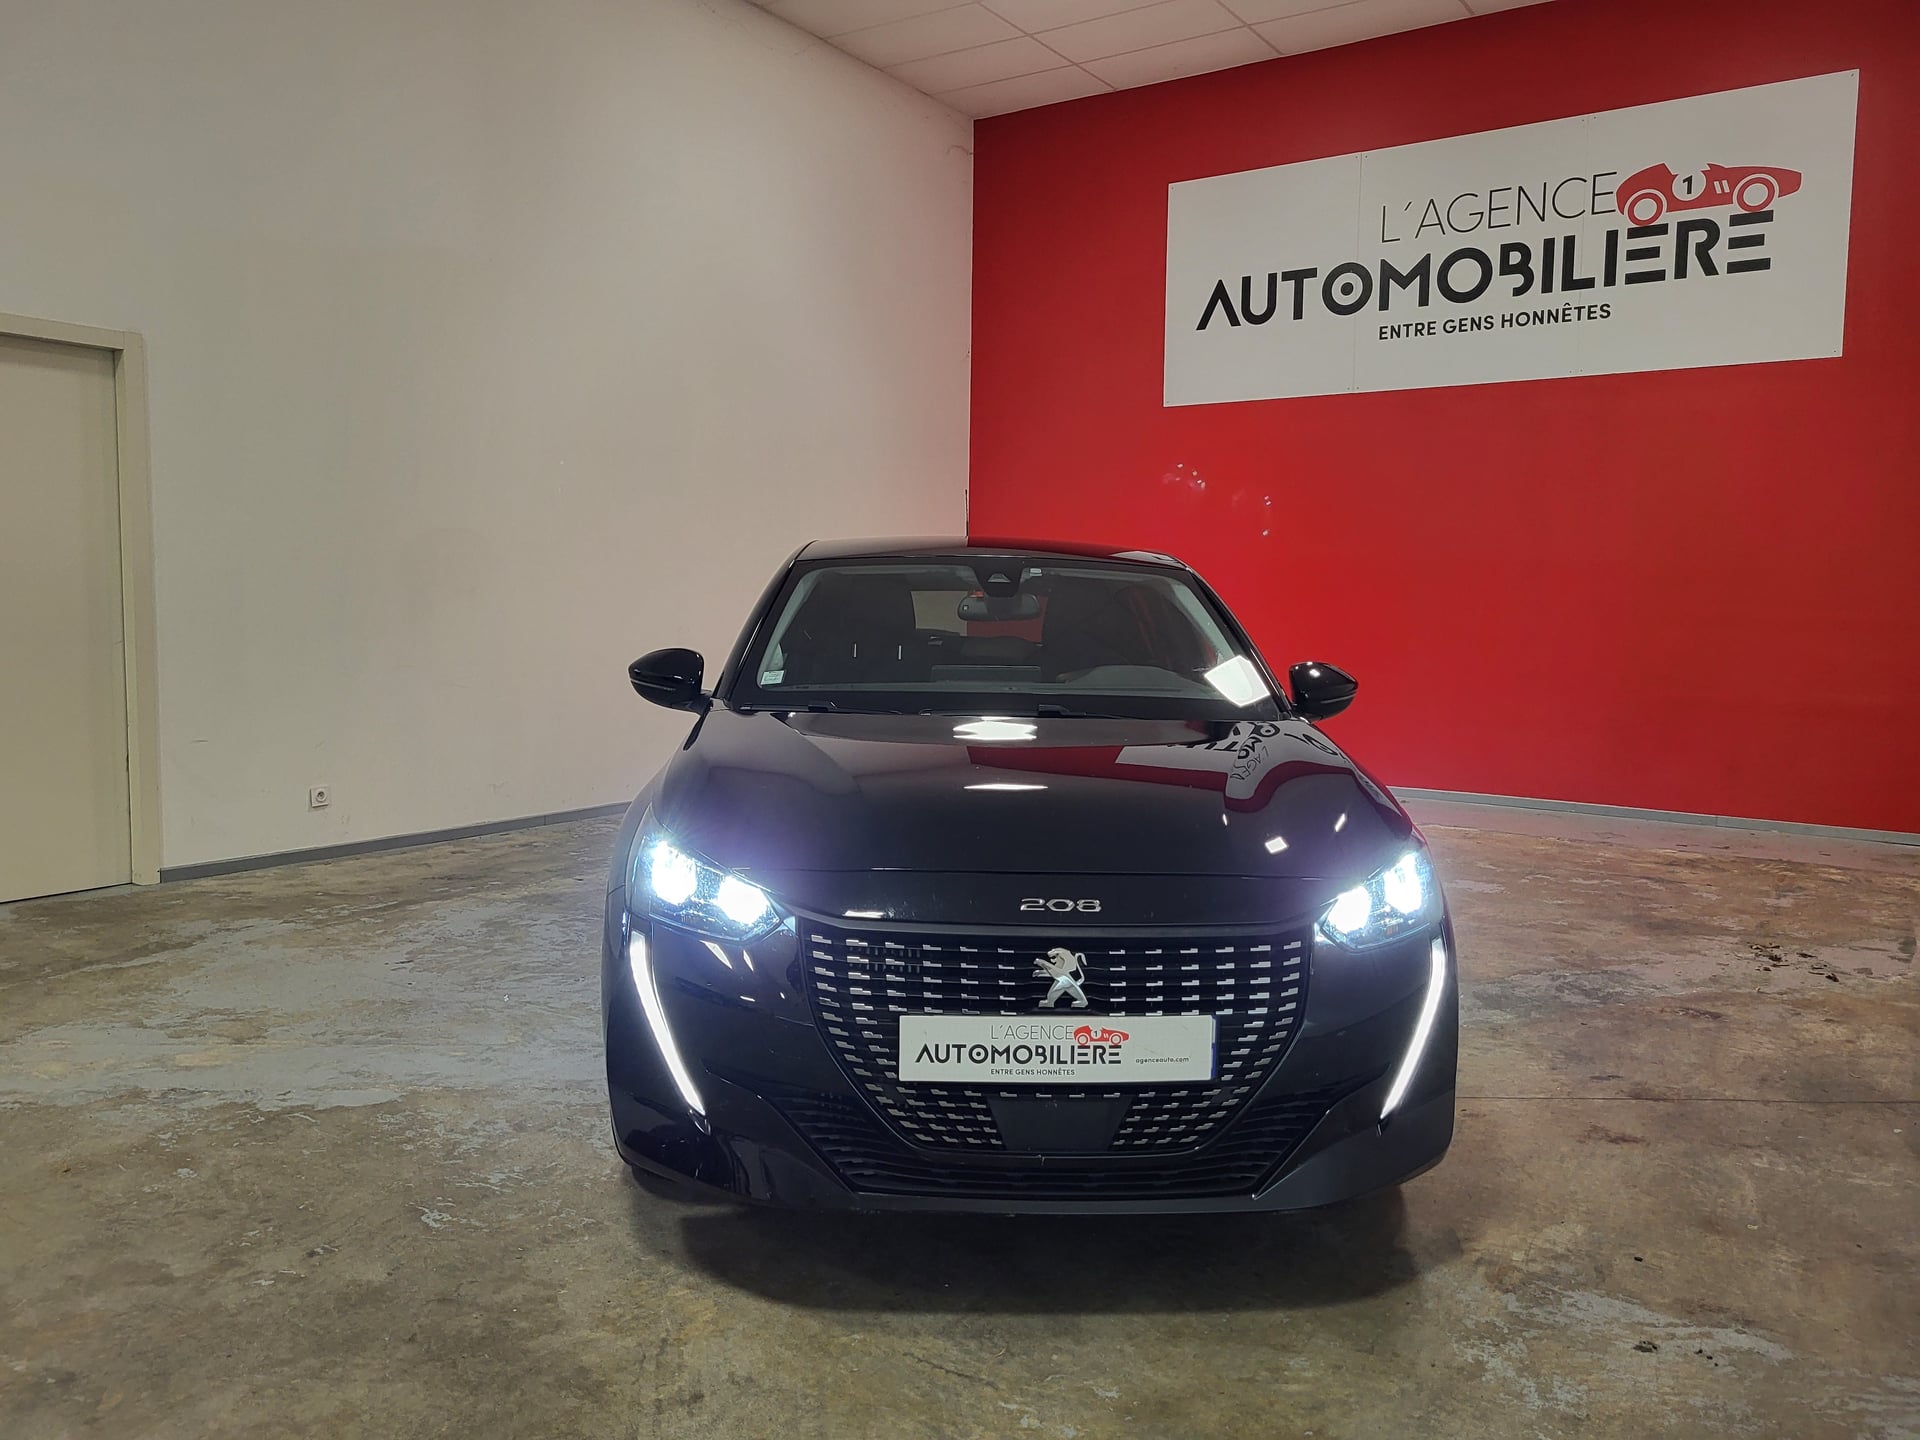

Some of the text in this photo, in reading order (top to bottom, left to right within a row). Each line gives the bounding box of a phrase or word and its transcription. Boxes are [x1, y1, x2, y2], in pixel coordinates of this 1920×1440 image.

[1682, 175, 1693, 195] 1
[1381, 171, 1618, 243] L'AGENCE
[1196, 209, 1774, 331] AUTOMOBILIERE
[1378, 302, 1611, 340] ENTRE GENS HONNÊTES
[1019, 898, 1102, 913] 208
[990, 1024, 1074, 1041] L'AGENCE
[915, 1043, 1122, 1065] AUTOMOBILIERE
[1135, 1056, 1190, 1065] agenceauto.com
[990, 1066, 1075, 1076] ENTRE GENS HONNÊTES
